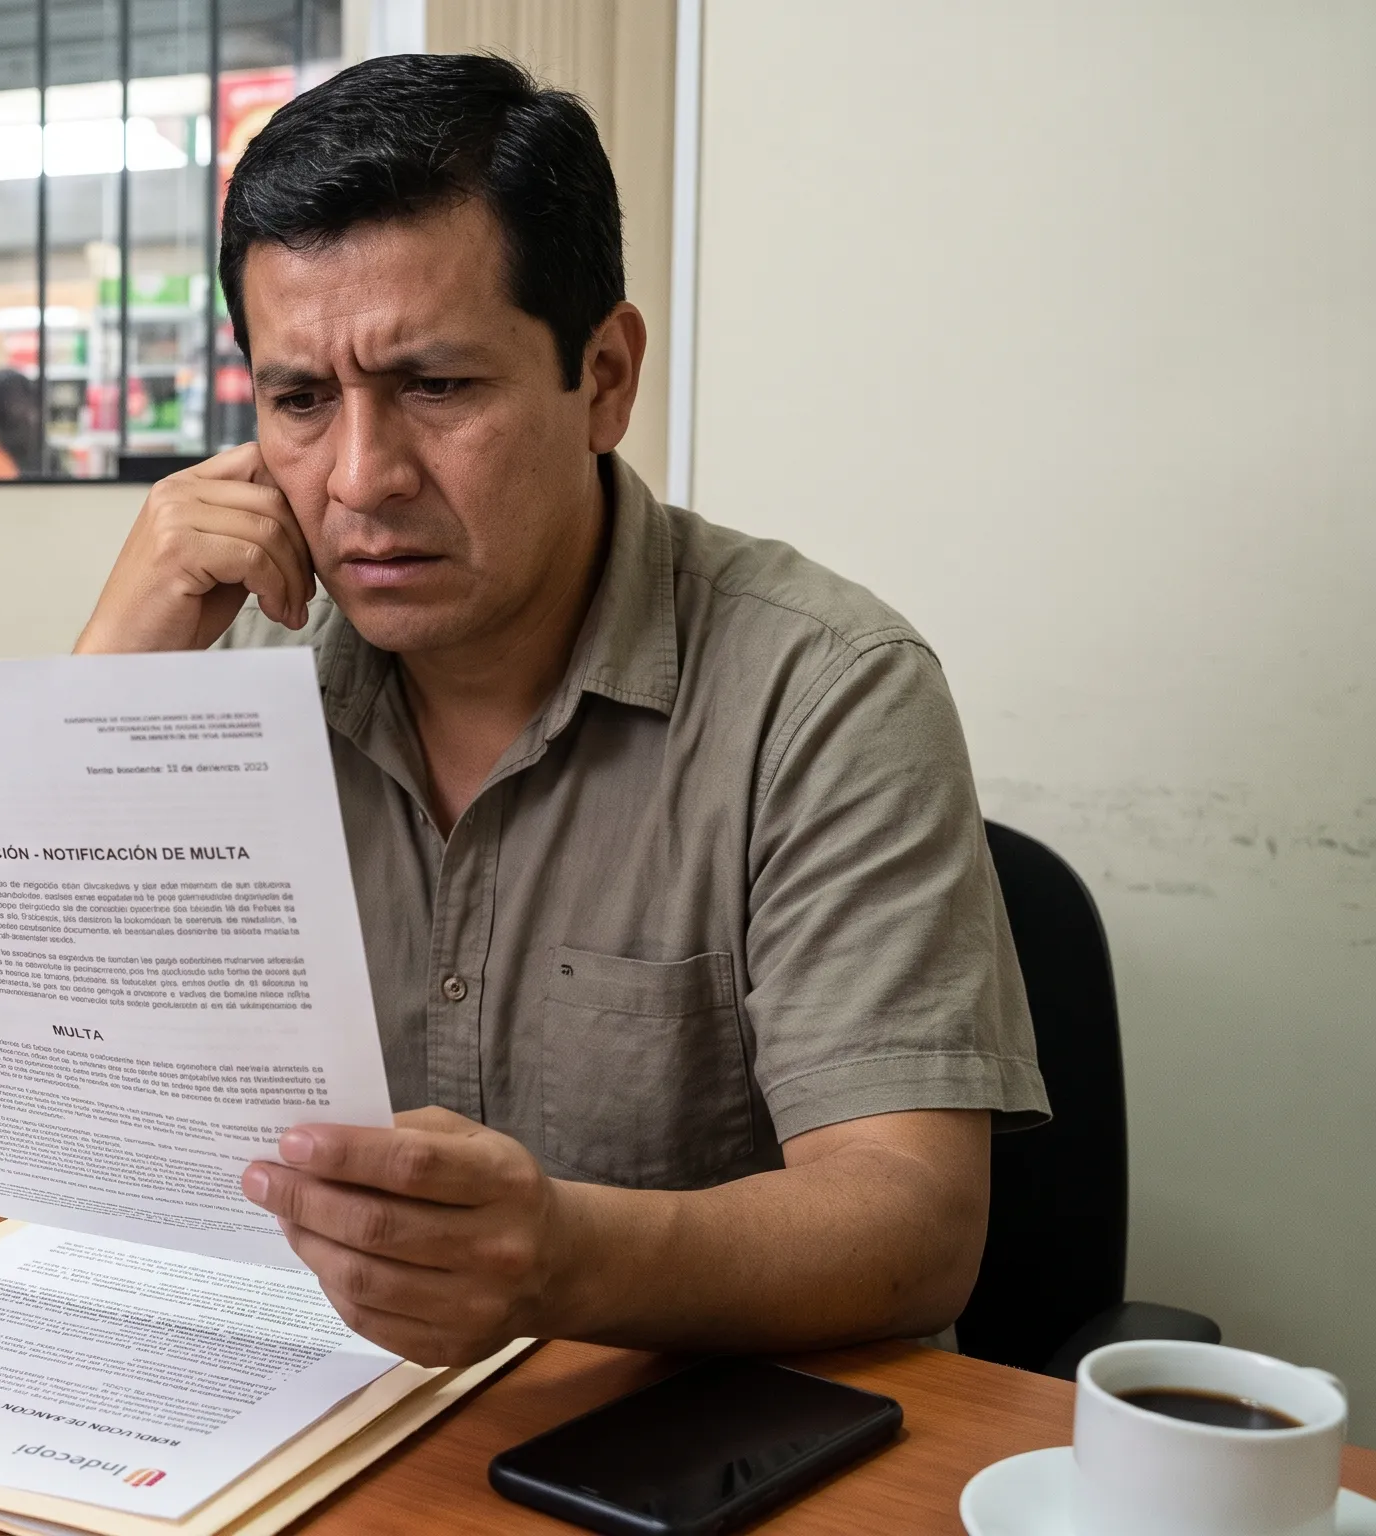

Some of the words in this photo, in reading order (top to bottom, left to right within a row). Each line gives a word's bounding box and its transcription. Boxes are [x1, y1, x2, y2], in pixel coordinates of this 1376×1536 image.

[43, 845, 158, 862] NOTIFICACIÓN
[162, 848, 186, 861] DE
[190, 846, 251, 860] MULTA
[52, 1024, 105, 1042] MULTA
[12, 1443, 128, 1476] Indecopi
